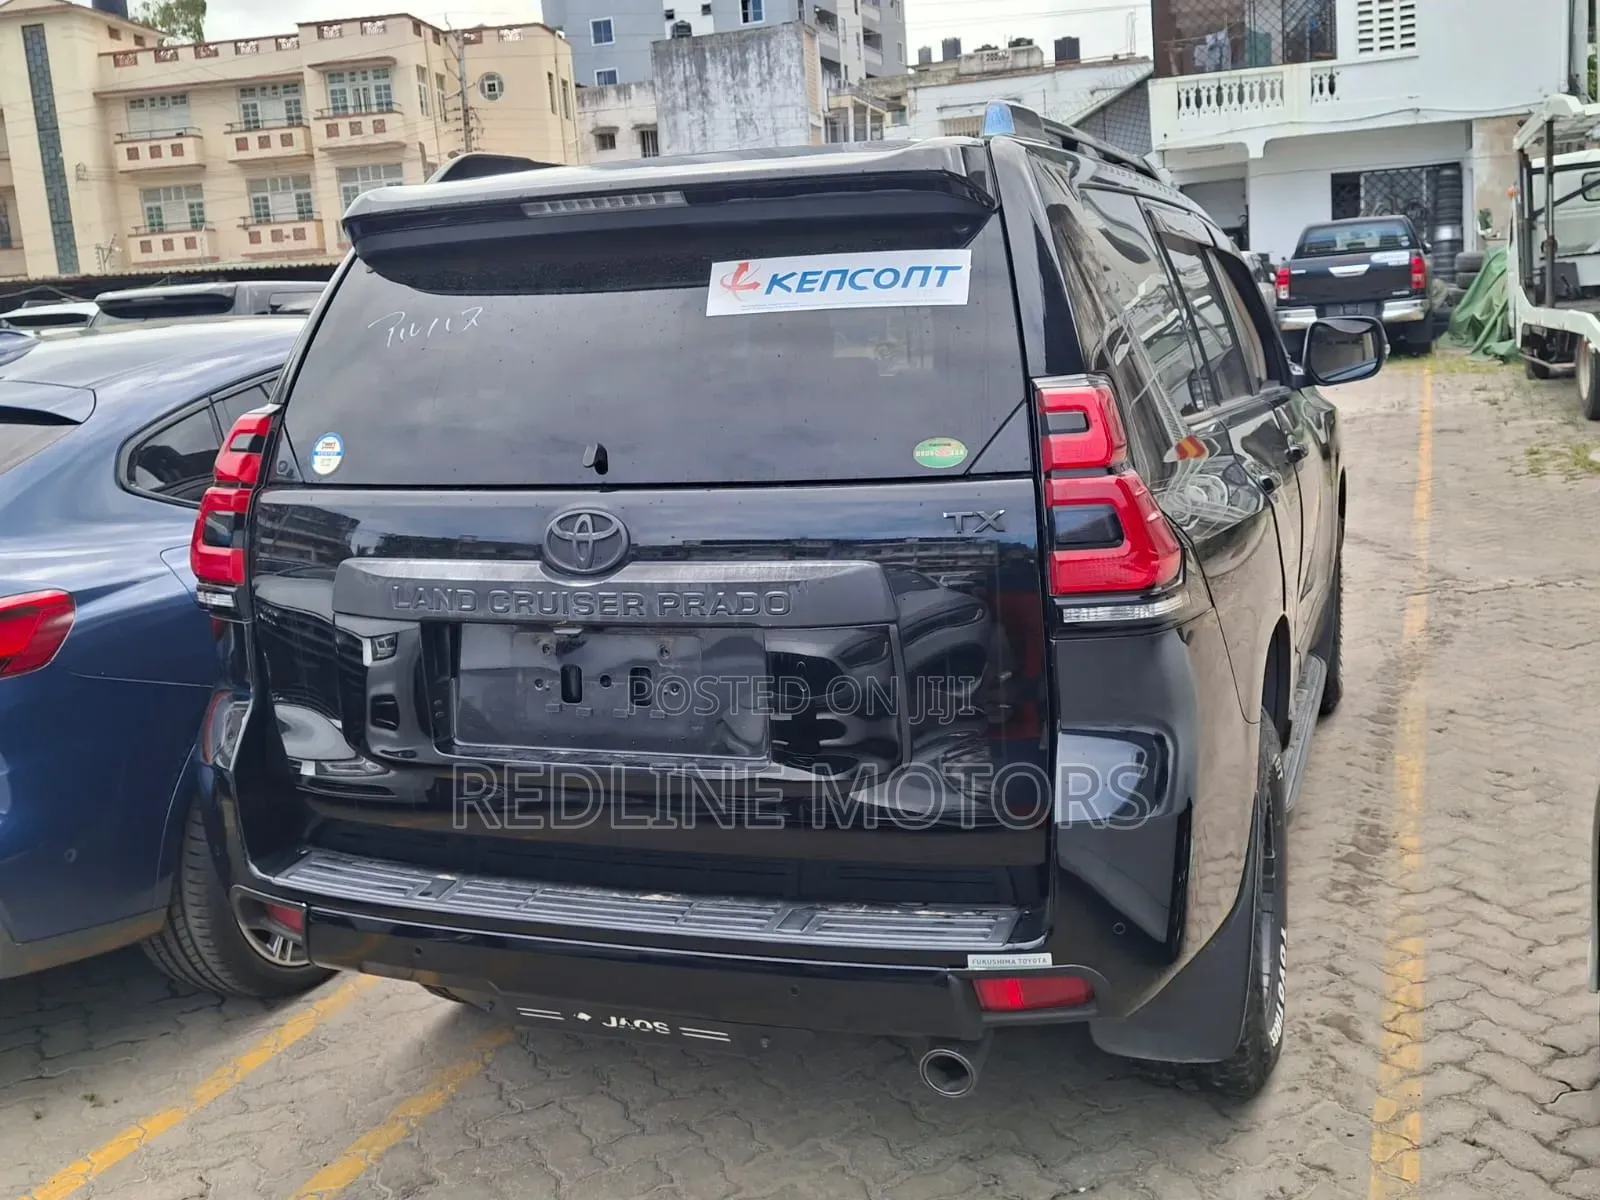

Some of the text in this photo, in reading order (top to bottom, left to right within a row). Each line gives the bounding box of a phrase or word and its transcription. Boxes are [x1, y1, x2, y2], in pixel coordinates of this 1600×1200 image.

[943, 509, 1006, 534] TX
[391, 584, 793, 617] LAND CRUISER PRADO
[971, 957, 1048, 966] FUKUSHIMA TOYOTA
